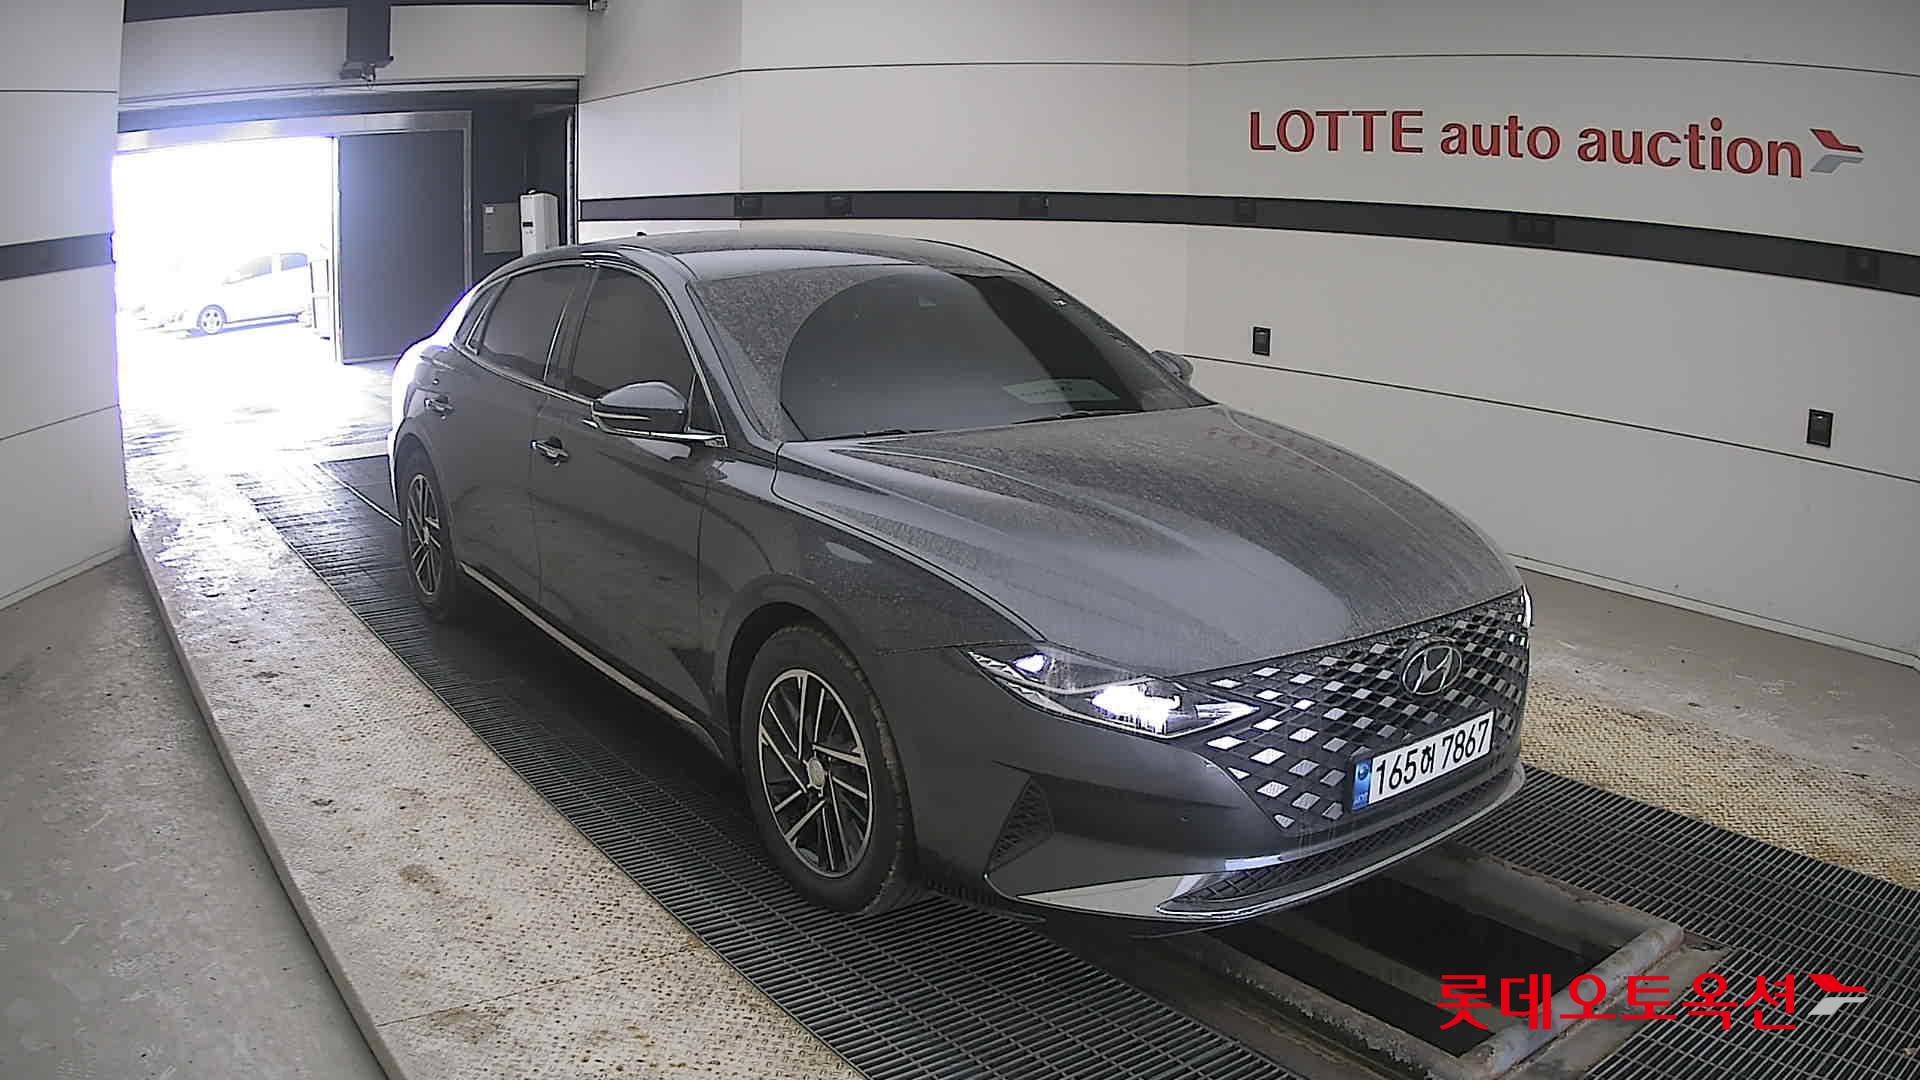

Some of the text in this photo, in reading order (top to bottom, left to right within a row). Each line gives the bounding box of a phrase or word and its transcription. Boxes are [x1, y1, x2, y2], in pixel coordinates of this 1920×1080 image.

[1248, 110, 1803, 179] LOTTE auto auction
[1376, 718, 1490, 794] 165허 7867
